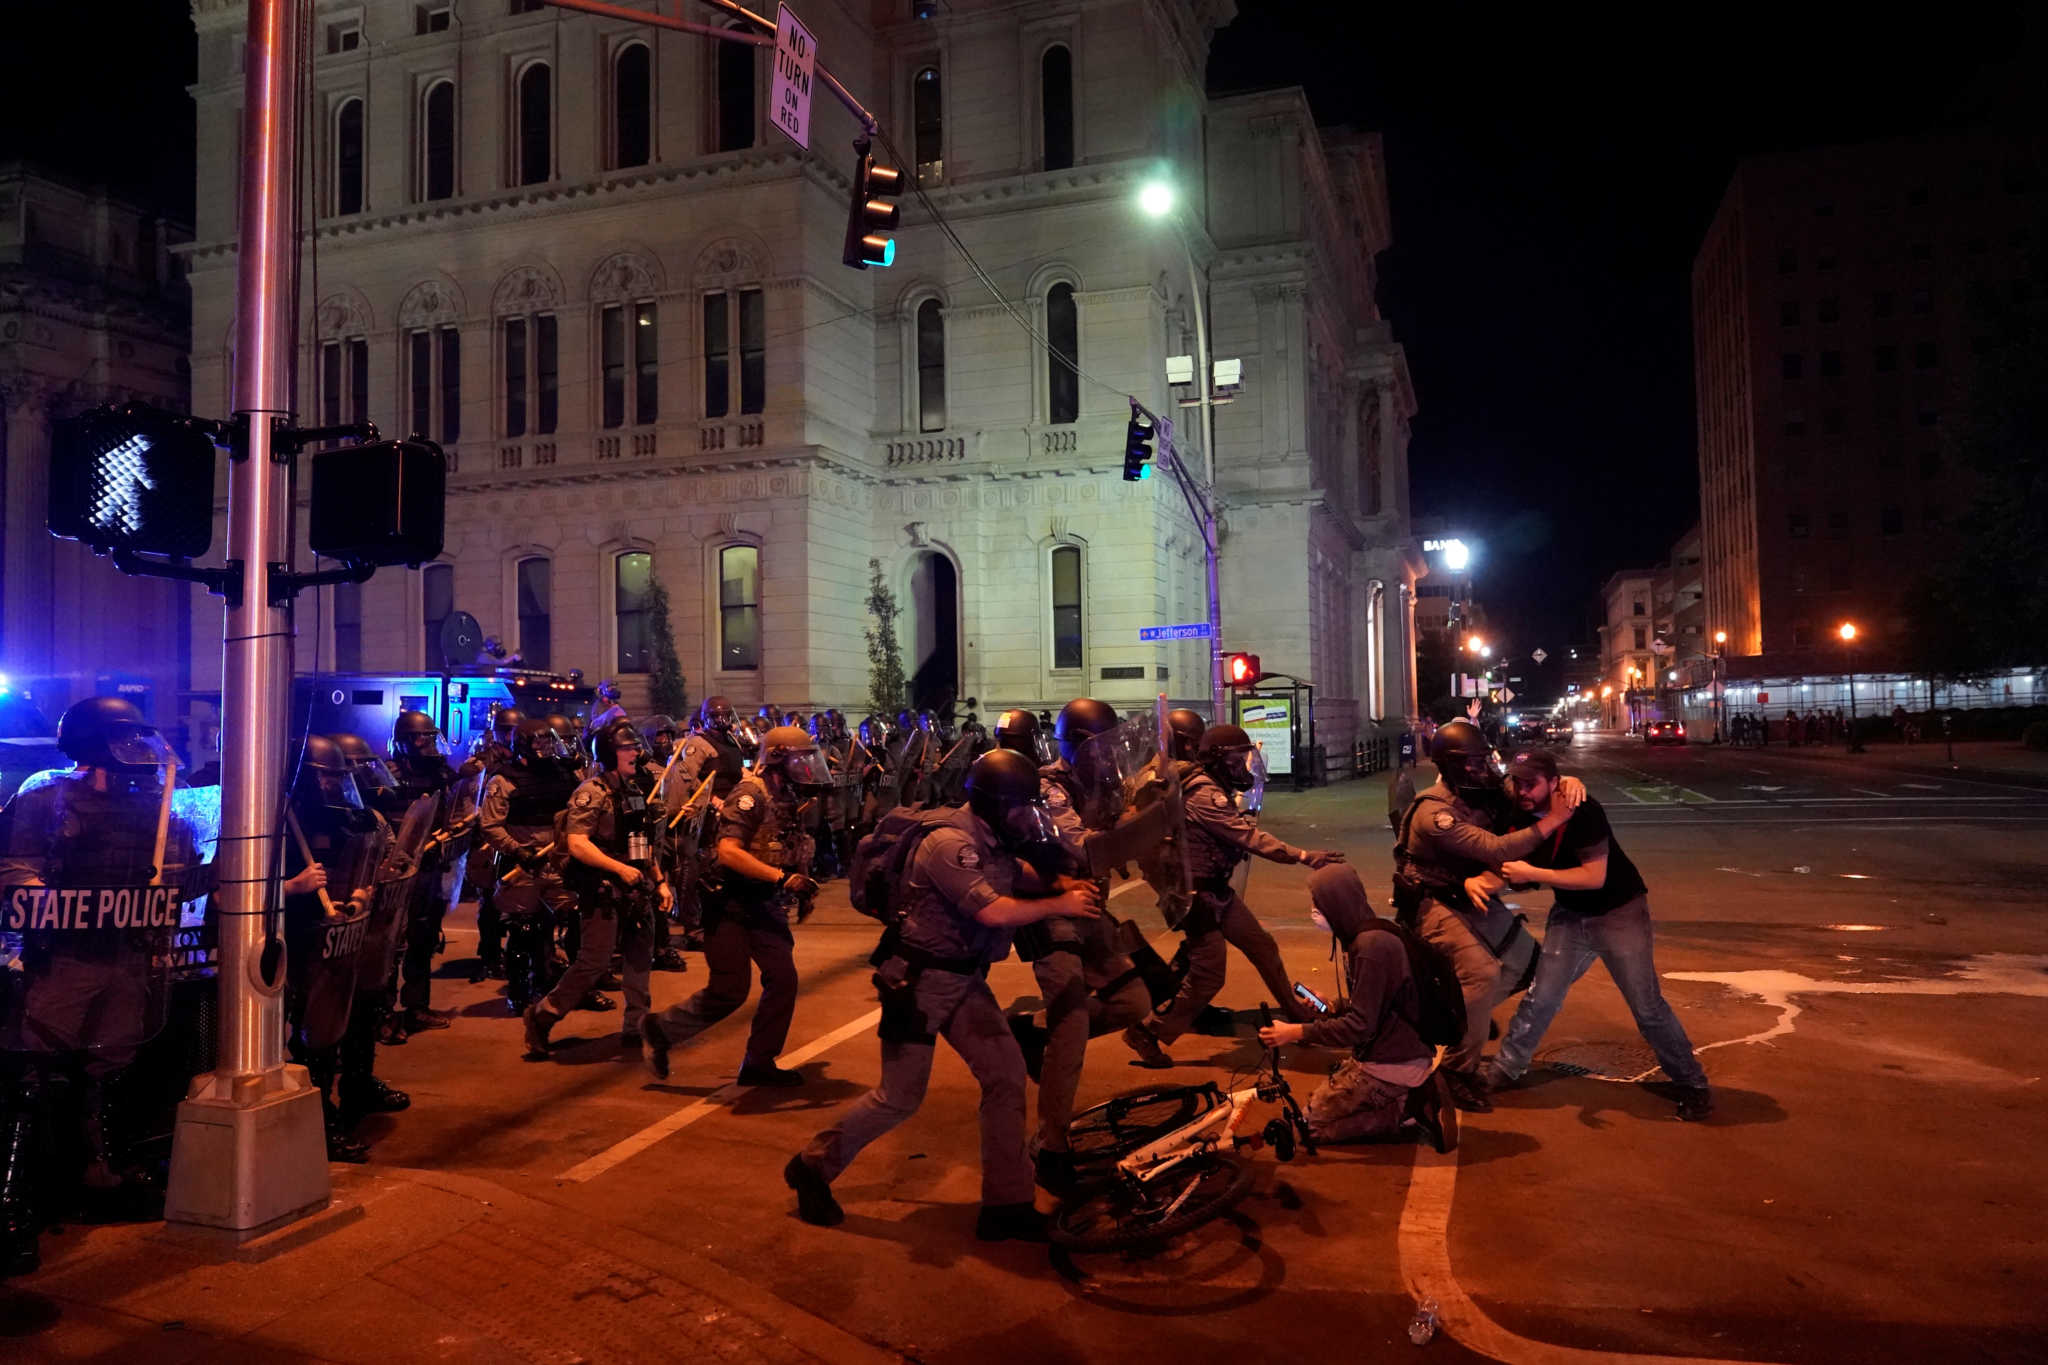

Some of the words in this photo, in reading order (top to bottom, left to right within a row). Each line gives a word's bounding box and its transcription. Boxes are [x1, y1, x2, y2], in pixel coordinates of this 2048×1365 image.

[789, 24, 806, 59] NO
[778, 48, 810, 97] TURN
[784, 87, 799, 112] ON
[780, 106, 799, 134] RED
[1156, 627, 1198, 638] Jefferson
[10, 888, 91, 930] STATE
[97, 888, 179, 930] POLICE
